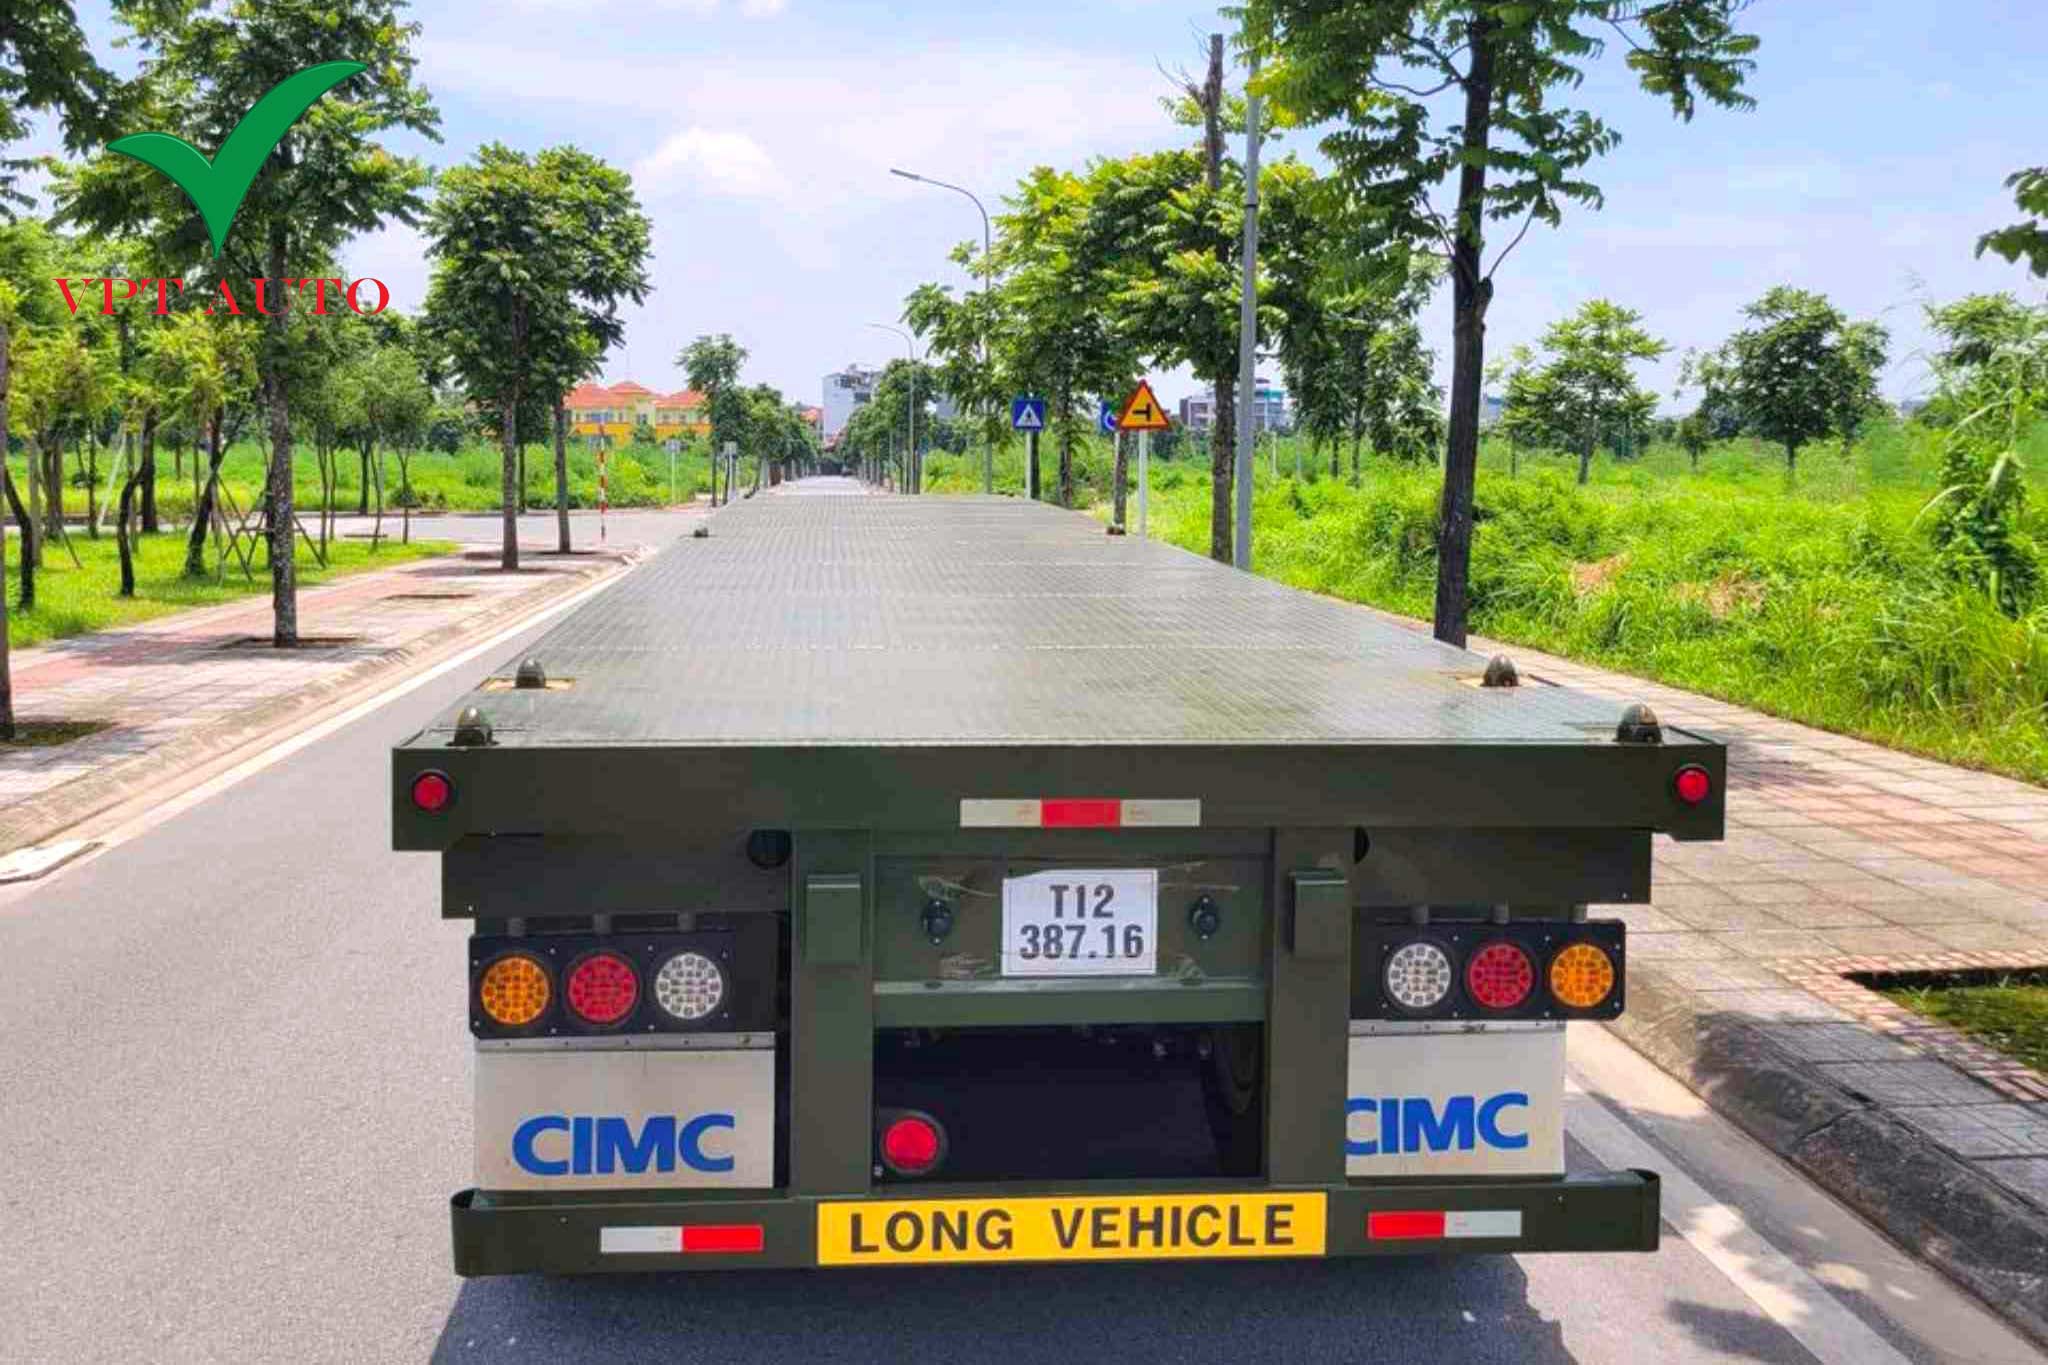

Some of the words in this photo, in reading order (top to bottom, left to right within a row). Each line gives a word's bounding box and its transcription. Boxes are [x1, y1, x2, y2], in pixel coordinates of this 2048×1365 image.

[1050, 884, 1114, 918] T12
[1019, 924, 1144, 960] 387.16
[511, 1114, 735, 1176] CIMC
[849, 1208, 1013, 1254] LONG
[1051, 1203, 1295, 1249] VEHICLE
